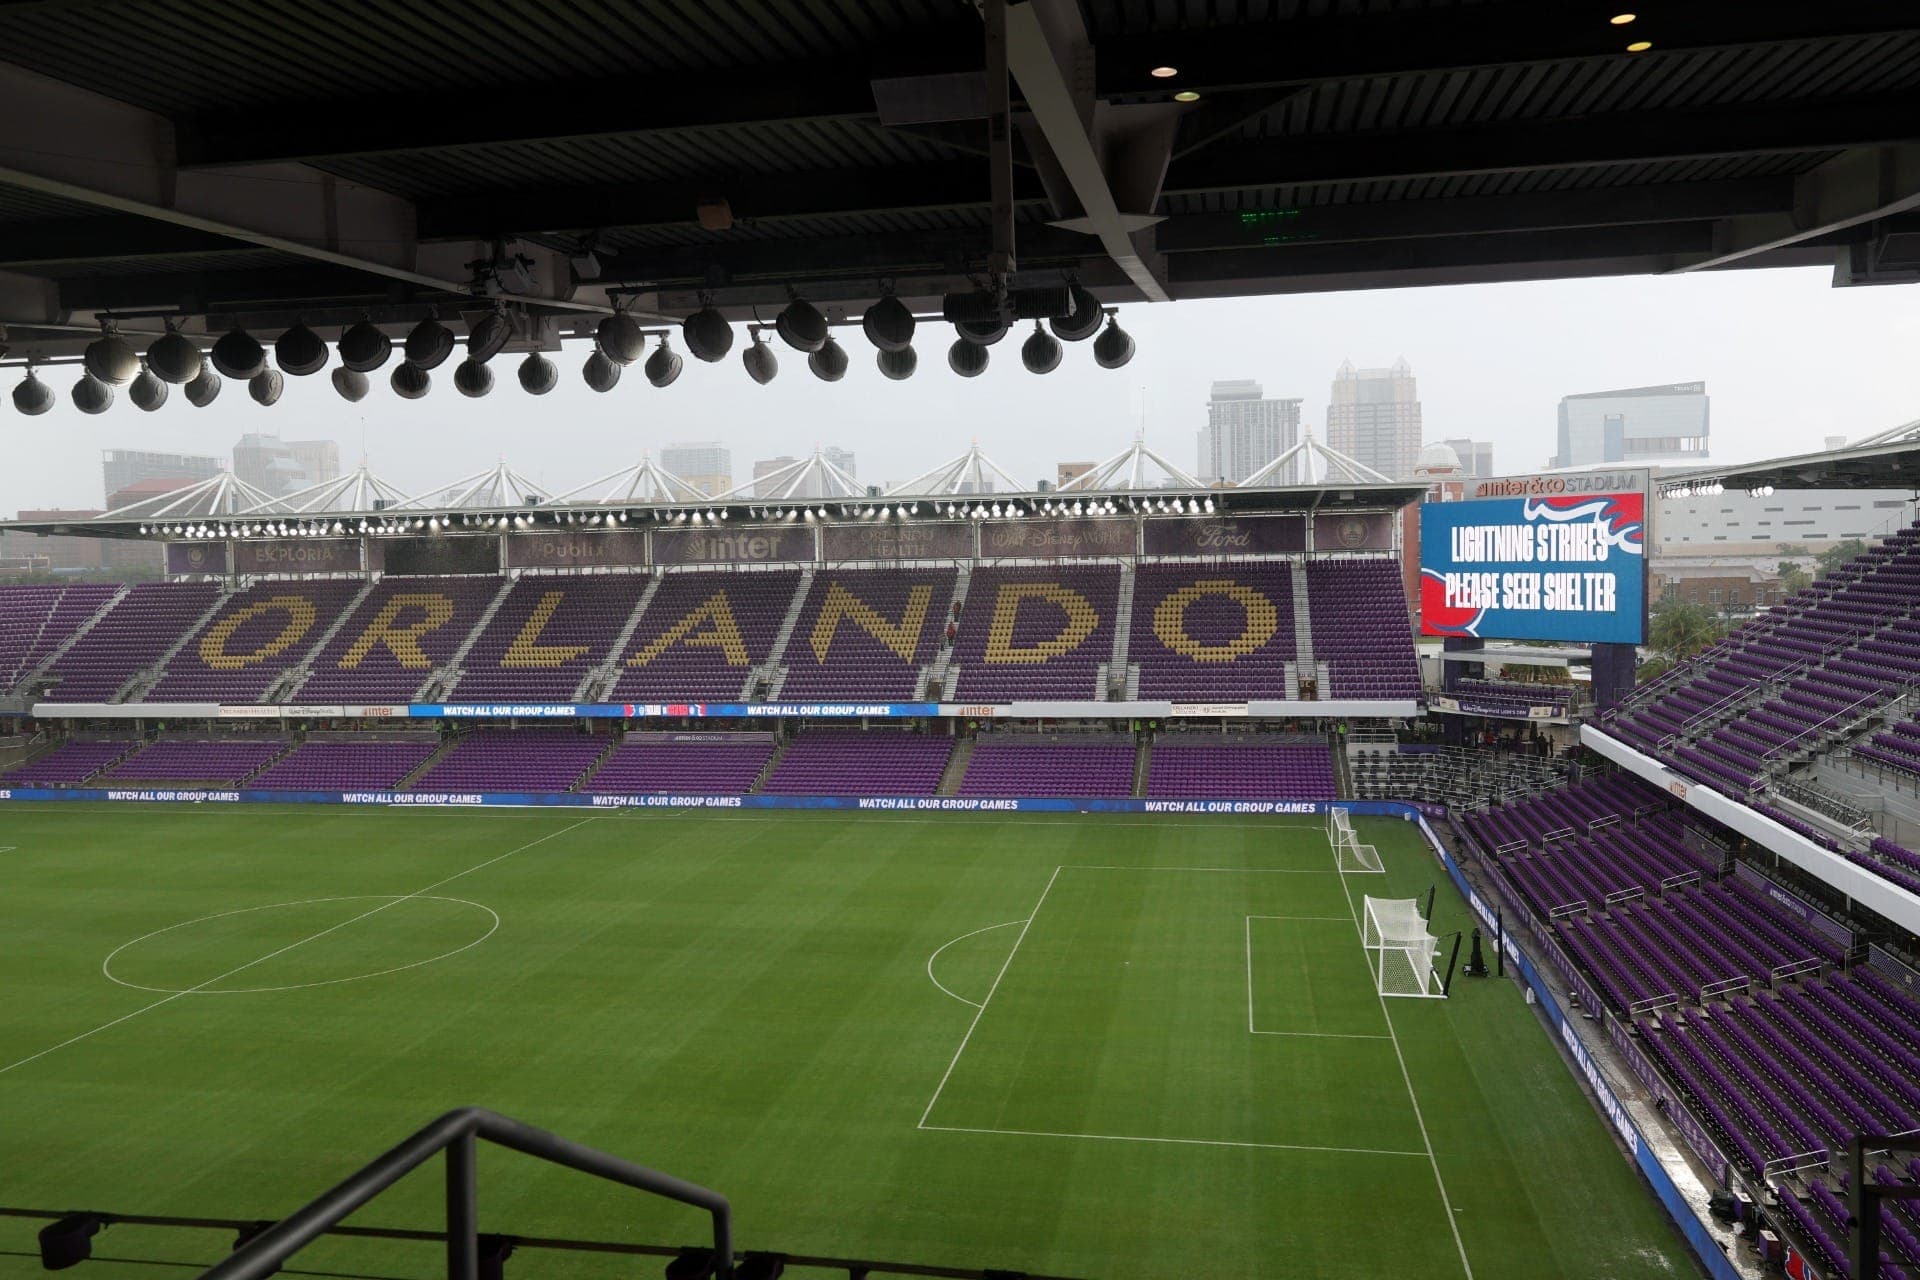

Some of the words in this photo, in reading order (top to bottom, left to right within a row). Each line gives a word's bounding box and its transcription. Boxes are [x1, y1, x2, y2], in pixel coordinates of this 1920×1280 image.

[1566, 474, 1637, 492] STADIUM
[1198, 524, 1250, 547] Ford
[710, 533, 782, 560] inter
[1452, 525, 1535, 563] LIGHTNING
[1537, 522, 1609, 562] STRIKES
[255, 547, 334, 561] EXPLORIA
[543, 541, 604, 558] Publix
[1445, 572, 1500, 609] PLEASE
[1502, 572, 1541, 610] SEEK
[1543, 572, 1616, 612] SHELTER
[367, 706, 394, 716] inter
[443, 706, 475, 715] WATCH
[475, 706, 491, 715] ALL
[492, 706, 512, 716] OUR
[512, 706, 543, 716] GROUP
[544, 706, 576, 716] GAMES
[747, 706, 782, 715] WATCH
[781, 706, 798, 715] ALL
[800, 706, 820, 716] OUR
[822, 705, 854, 716] GROUP
[856, 705, 890, 716] GAMES
[966, 705, 995, 716] inter
[108, 791, 143, 800] WATCH
[139, 791, 156, 800] ALL
[157, 792, 175, 800] OUR
[177, 792, 207, 801] GROUP
[208, 792, 240, 801] GAMES
[343, 793, 375, 803] WATCH
[376, 793, 392, 803] ALL
[394, 794, 414, 804] OUR
[415, 794, 448, 804] GROUP
[449, 794, 482, 804] GAMES
[592, 795, 629, 806] WATCH
[628, 796, 646, 806] ALL
[648, 796, 669, 806] OUR
[670, 796, 704, 807] GROUP
[705, 797, 741, 807] GAMES
[859, 798, 895, 808] WATCH
[896, 798, 915, 808] ALL
[918, 799, 940, 808] OUR
[942, 800, 978, 809] GROUP
[980, 800, 1018, 809] GAMES
[1145, 801, 1184, 811] WATCH
[1186, 802, 1206, 812] ALL
[1208, 802, 1232, 812] OUR
[1234, 802, 1273, 812] GROUP
[1275, 803, 1316, 813] GAMES
[1615, 1107, 1638, 1155] GAMES
